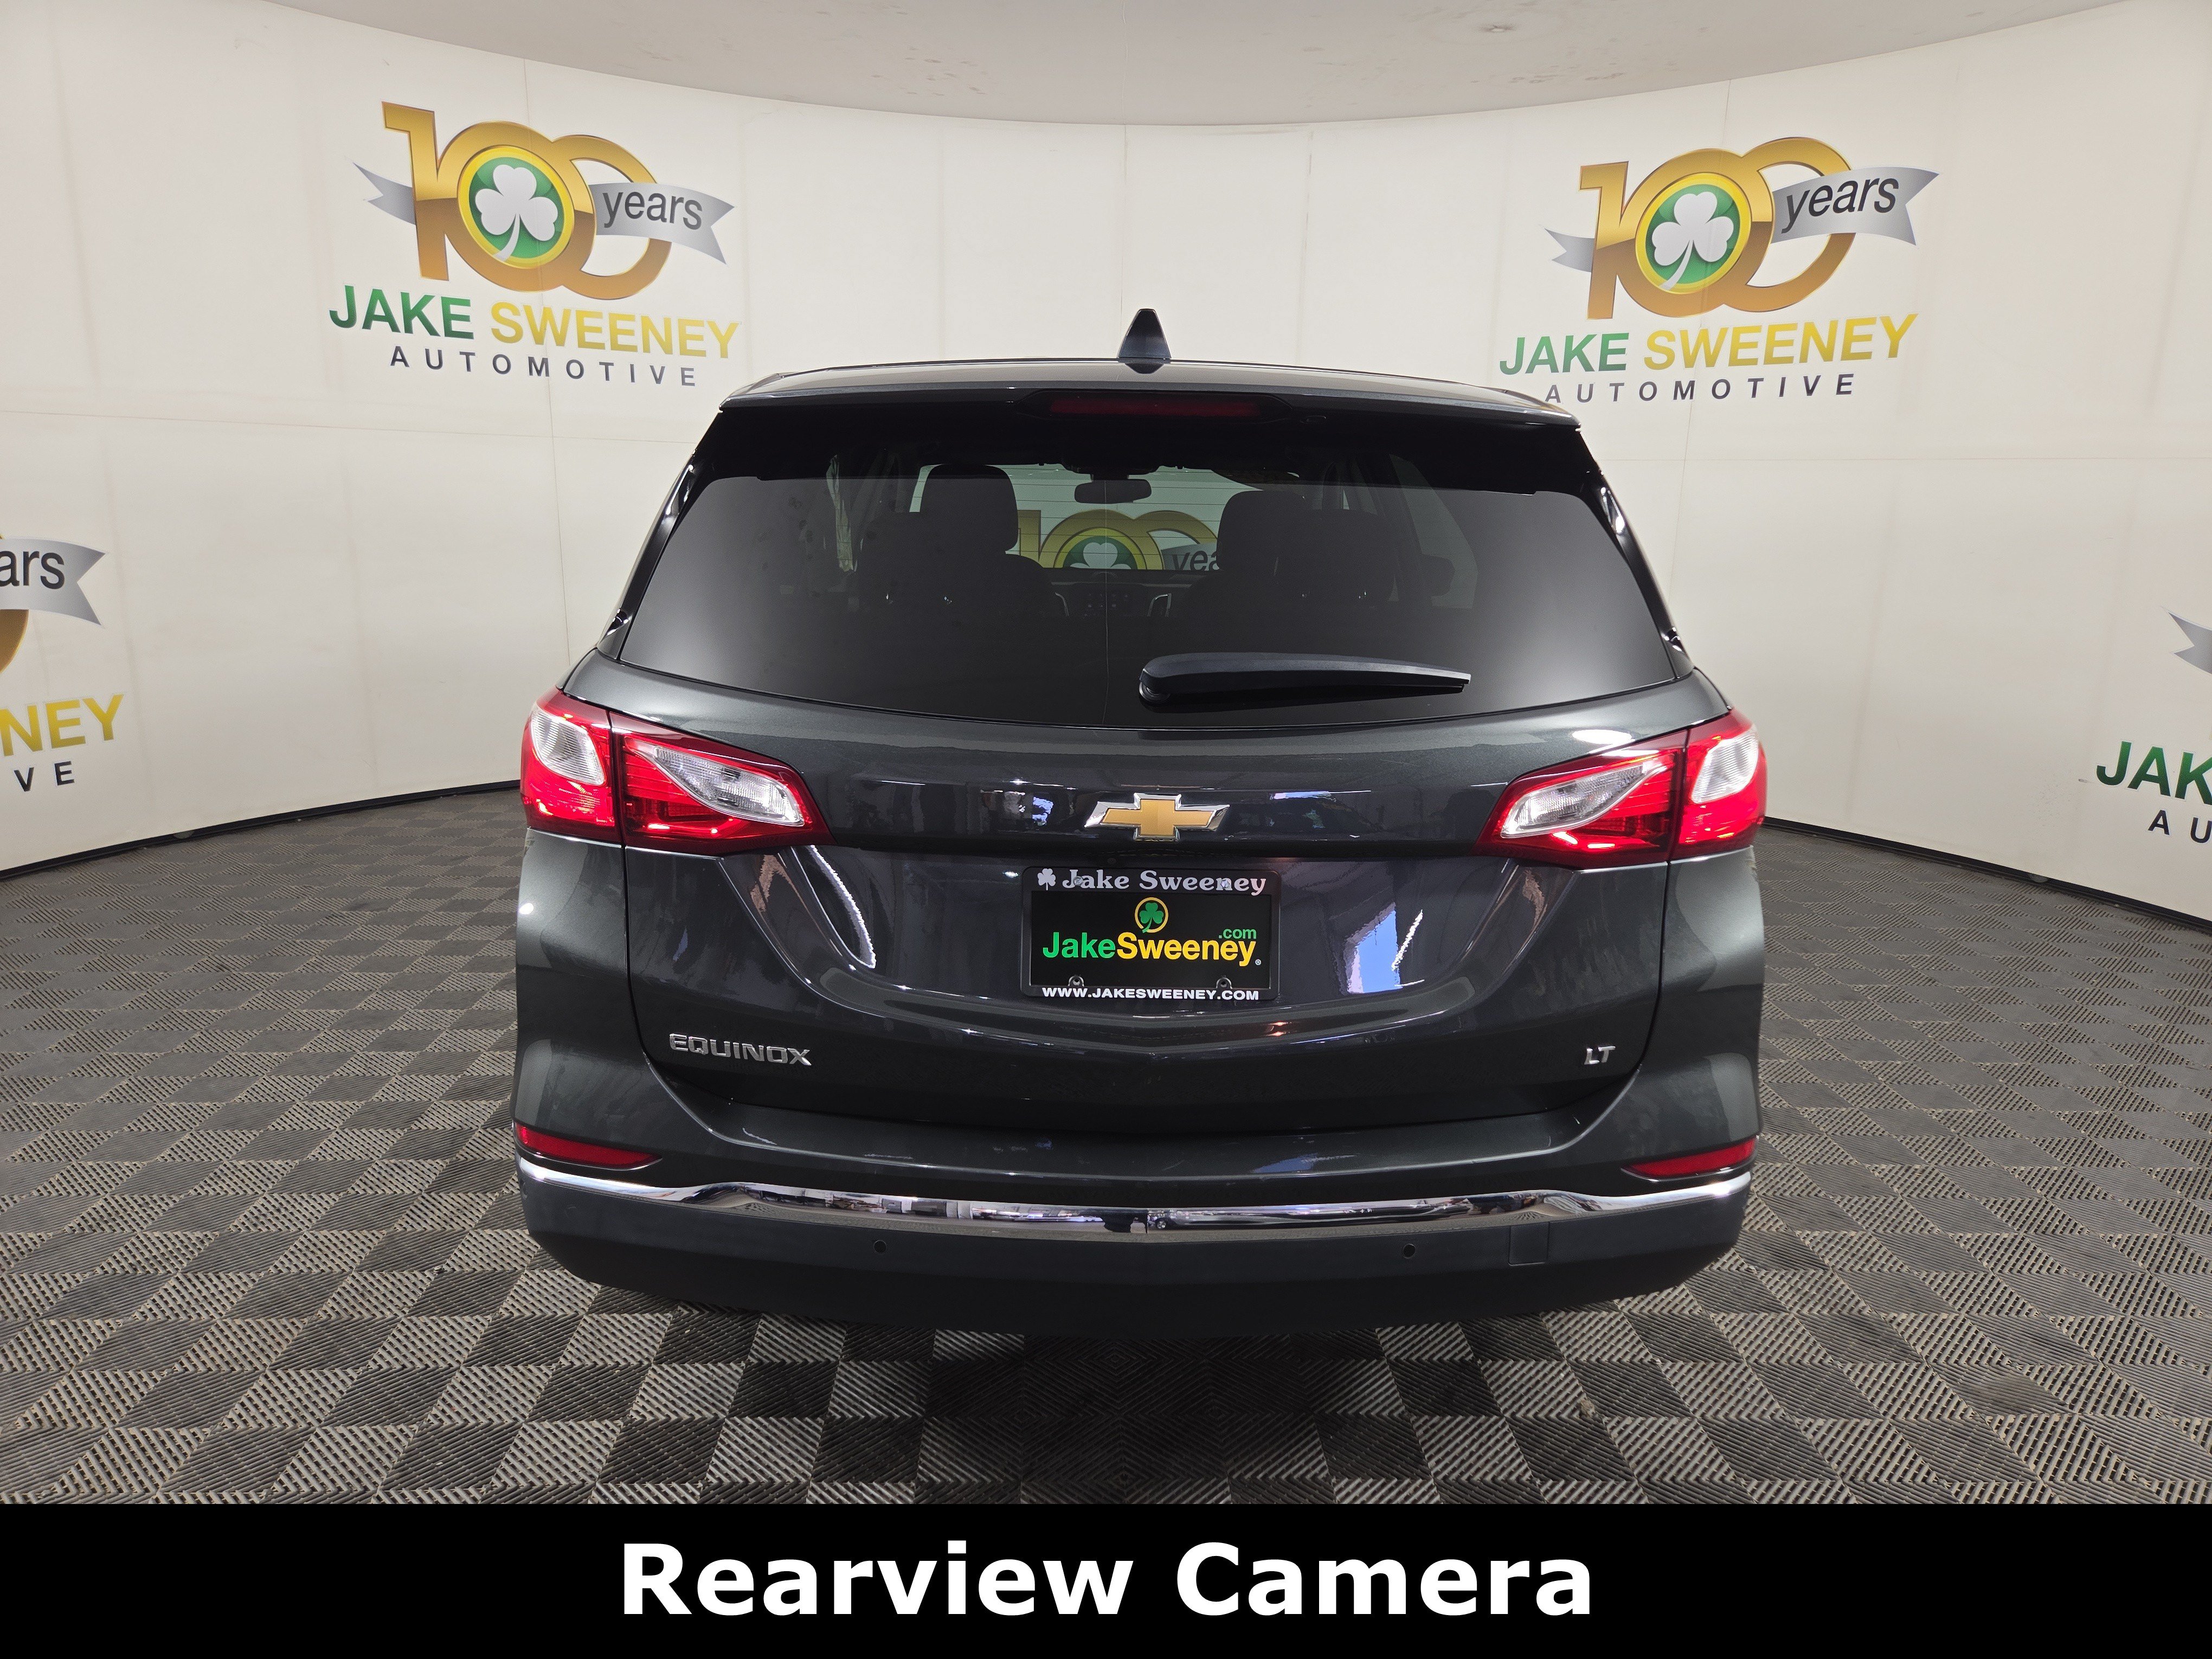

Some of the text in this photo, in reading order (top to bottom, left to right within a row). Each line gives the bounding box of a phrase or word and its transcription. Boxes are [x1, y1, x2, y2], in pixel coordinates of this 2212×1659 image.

[382, 101, 703, 300] 100 years
[1579, 137, 1899, 319] 100 years
[329, 285, 741, 359] JAKE SWEENEY
[1500, 313, 1919, 375] JAKE SWEENEY
[390, 345, 696, 387] AUTOMOTIVE
[1545, 373, 1855, 403] AUTOMOTIVE
[1062, 869, 1266, 896] Jake Sweeney
[1043, 987, 1259, 1001] WWW.JAKESWEENEY.COM
[669, 1033, 812, 1066] EQUINOX
[1584, 1045, 1616, 1065] LT
